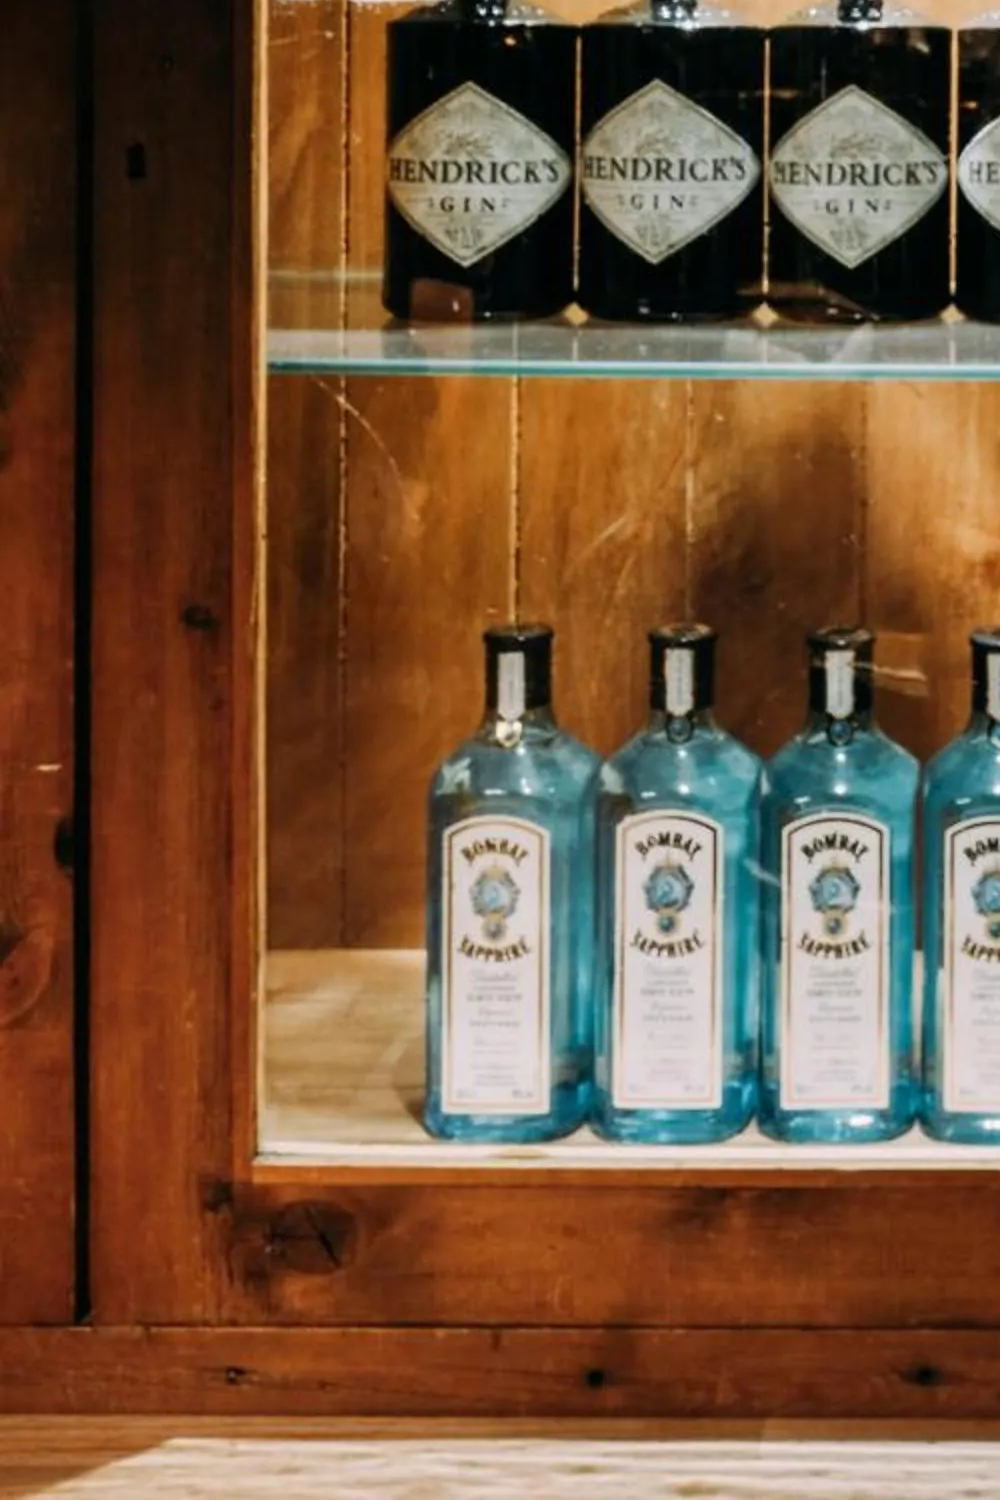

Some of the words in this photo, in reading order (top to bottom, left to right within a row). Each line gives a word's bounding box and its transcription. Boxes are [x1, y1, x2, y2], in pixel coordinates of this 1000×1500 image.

[390, 157, 560, 185] HENDRICK'S
[584, 155, 747, 181] HENDRICK'S
[774, 160, 939, 186] HENDRICK'S
[440, 196, 497, 213] GIN
[630, 195, 685, 210] GIN
[825, 198, 879, 214] GIN
[461, 838, 529, 867] BOMBAY
[634, 831, 703, 861] BOMBAY
[801, 832, 869, 864] BOMBAY
[457, 936, 530, 963] SAPPHIRE
[630, 930, 704, 959] SAPPHIRE
[797, 932, 870, 960] SAPPHIRE
